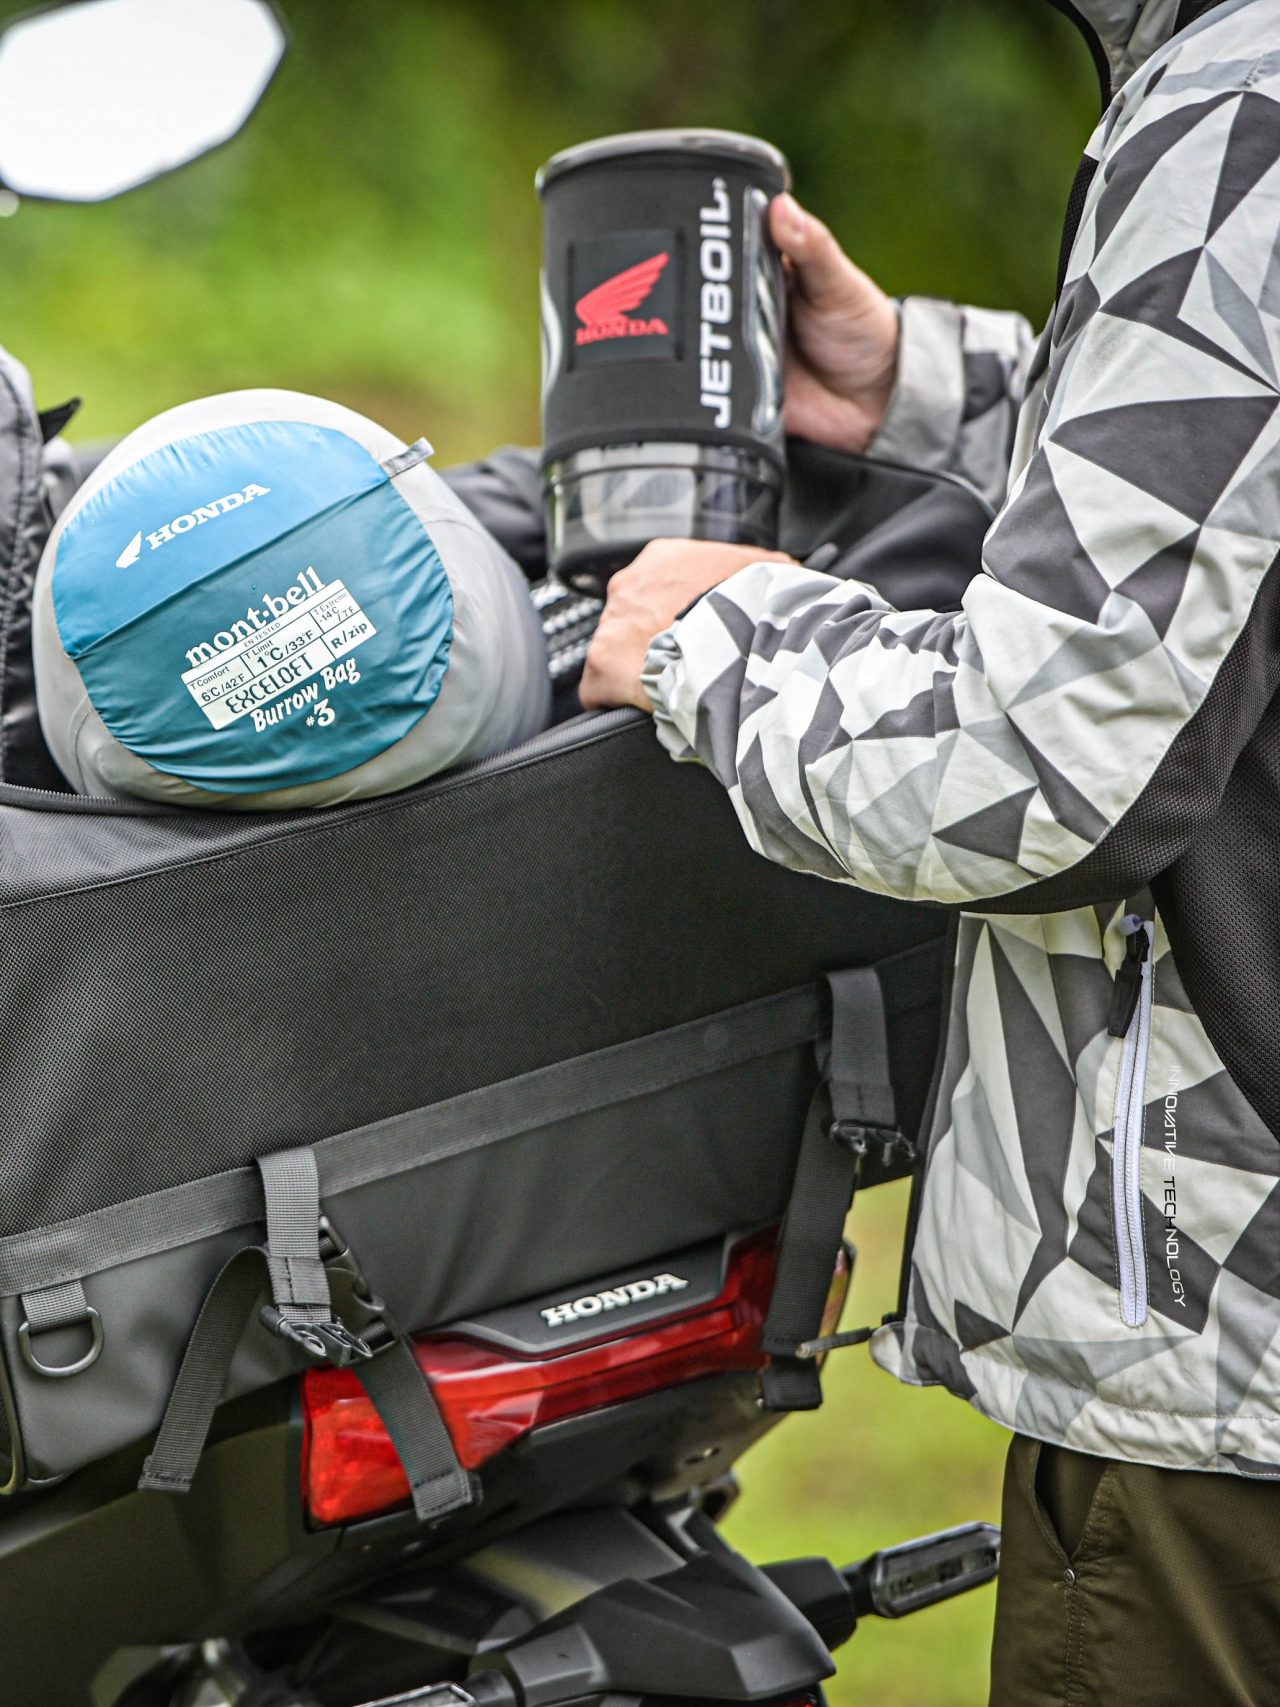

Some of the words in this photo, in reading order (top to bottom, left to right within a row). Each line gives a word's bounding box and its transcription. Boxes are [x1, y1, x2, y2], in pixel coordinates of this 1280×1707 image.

[575, 318, 670, 346] HONDA
[700, 188, 732, 429] JETBOIL
[145, 483, 270, 550] HONDA
[243, 639, 255, 648] EN
[255, 622, 281, 641] TESTED
[252, 640, 274, 656] Limit
[331, 623, 368, 649] R/zip
[190, 683, 197, 691] T
[197, 666, 230, 688] Comfort
[225, 652, 313, 714] EXCELOFT
[250, 682, 319, 732] Burrow
[319, 657, 361, 691] Bag
[305, 699, 336, 727] #3
[1163, 1065, 1181, 1172] INNOVATIVE
[1163, 1176, 1186, 1307] TECHNOLOGY
[541, 1273, 689, 1327] HONDA
